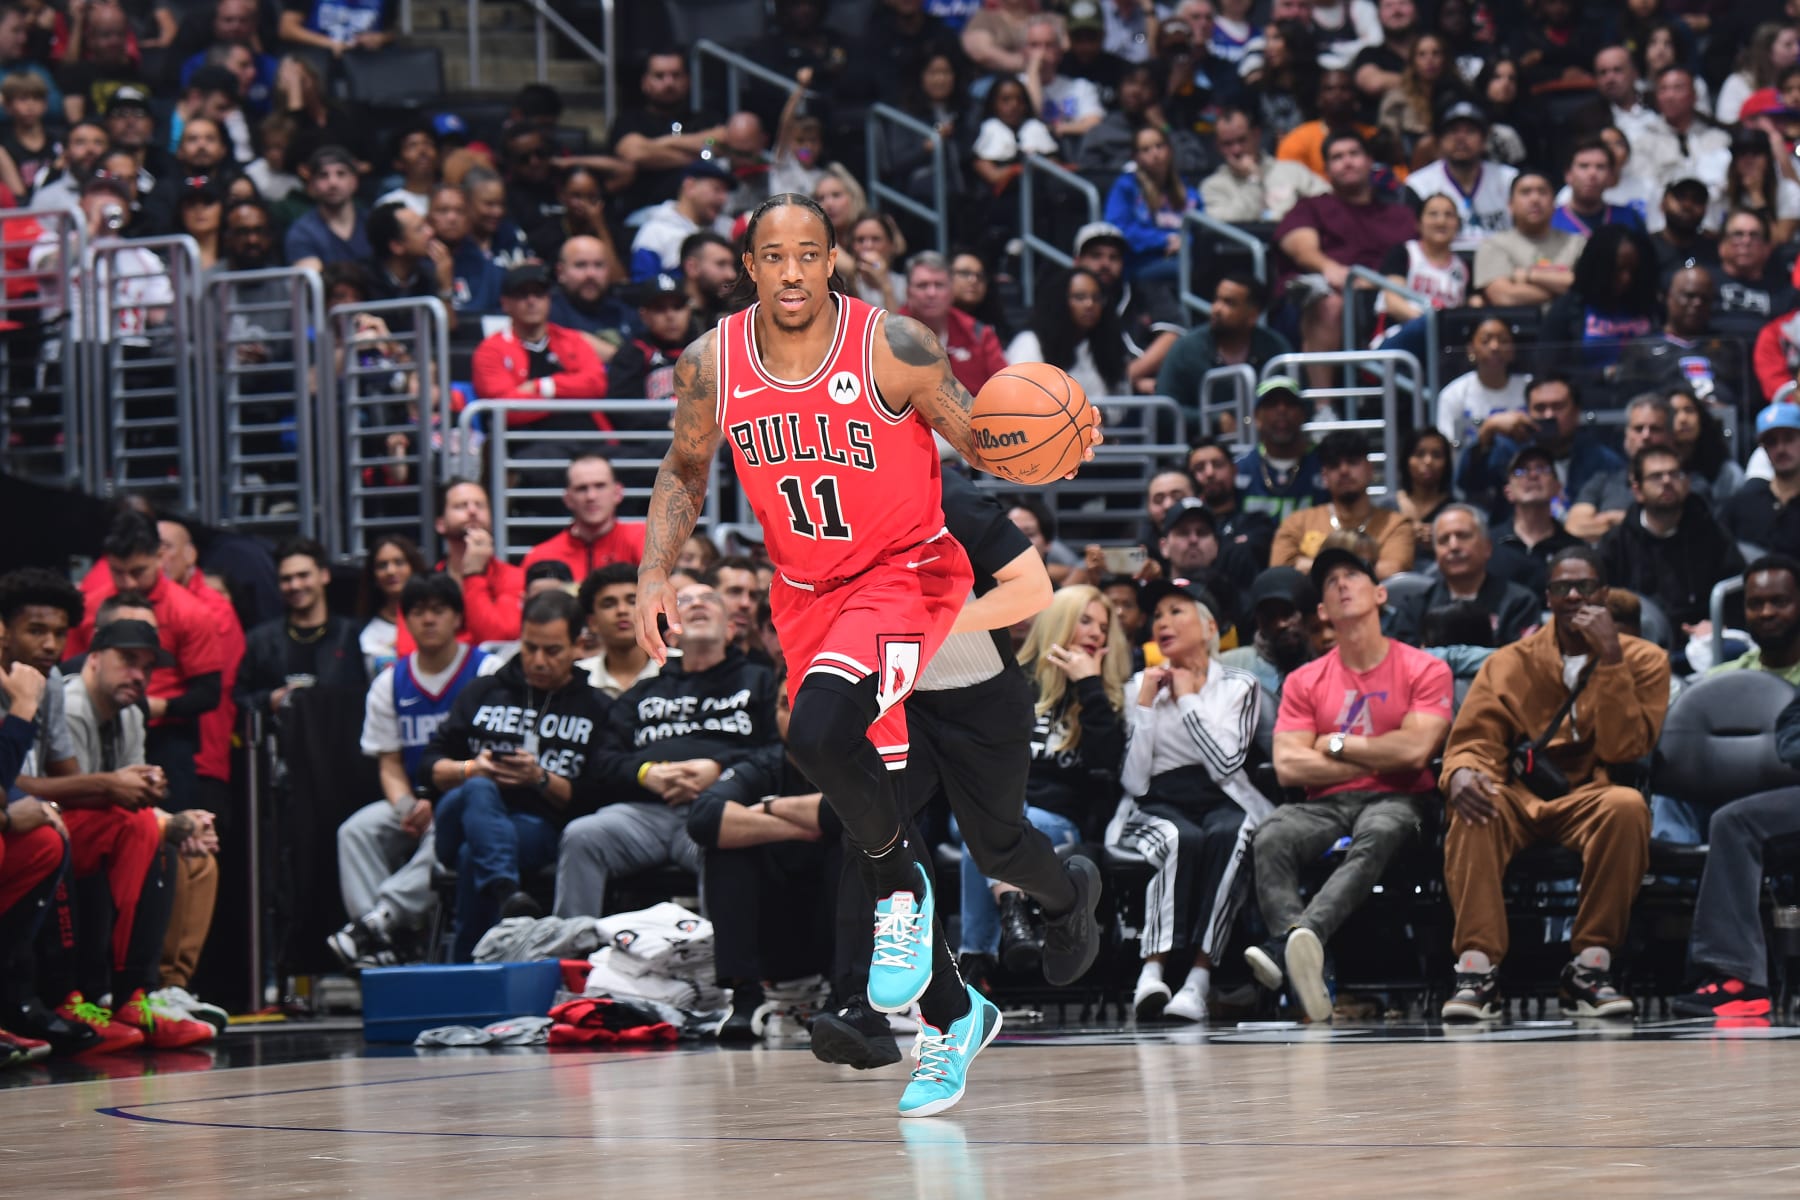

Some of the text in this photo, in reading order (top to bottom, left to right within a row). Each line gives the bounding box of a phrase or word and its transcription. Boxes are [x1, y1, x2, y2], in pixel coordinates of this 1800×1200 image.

[729, 412, 877, 472] BULLS
[776, 475, 852, 541] 11
[472, 704, 594, 745] FREE OUR
